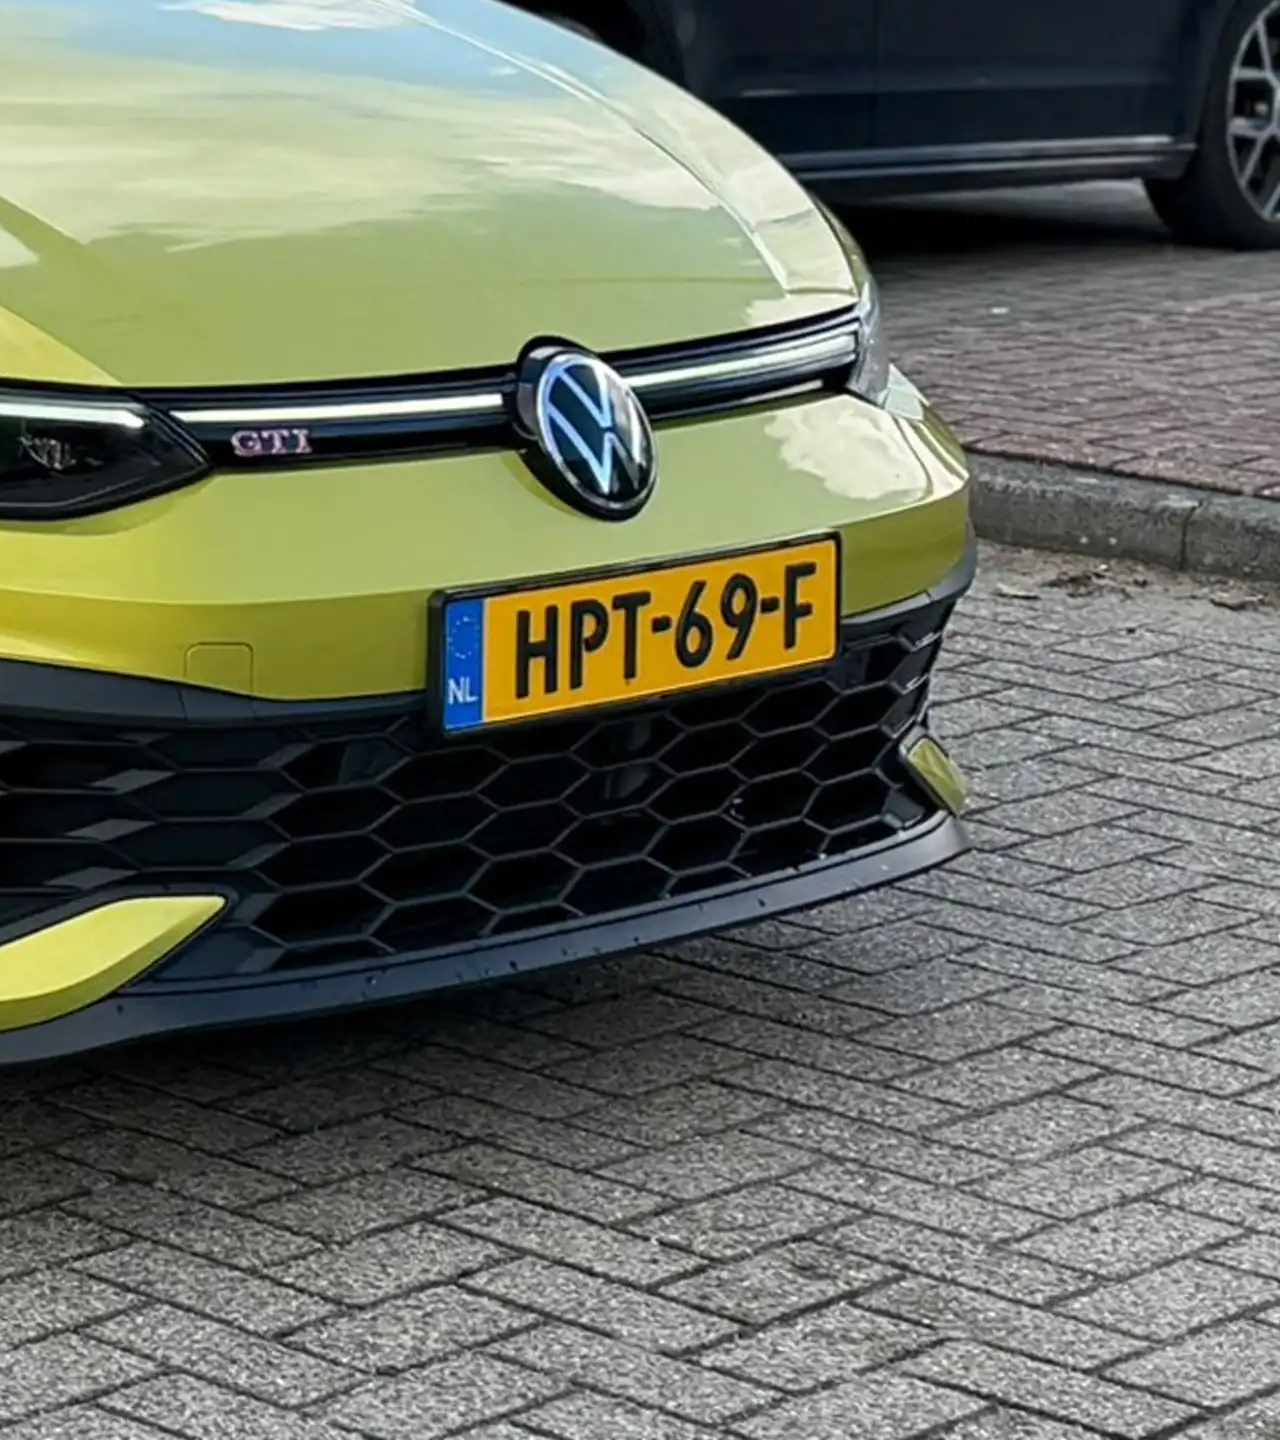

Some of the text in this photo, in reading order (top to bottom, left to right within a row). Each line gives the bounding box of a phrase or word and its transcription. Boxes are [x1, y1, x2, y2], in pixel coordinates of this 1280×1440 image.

[231, 428, 313, 457] GTI
[515, 562, 817, 699] HPT-69-F
[448, 676, 478, 705] NL
